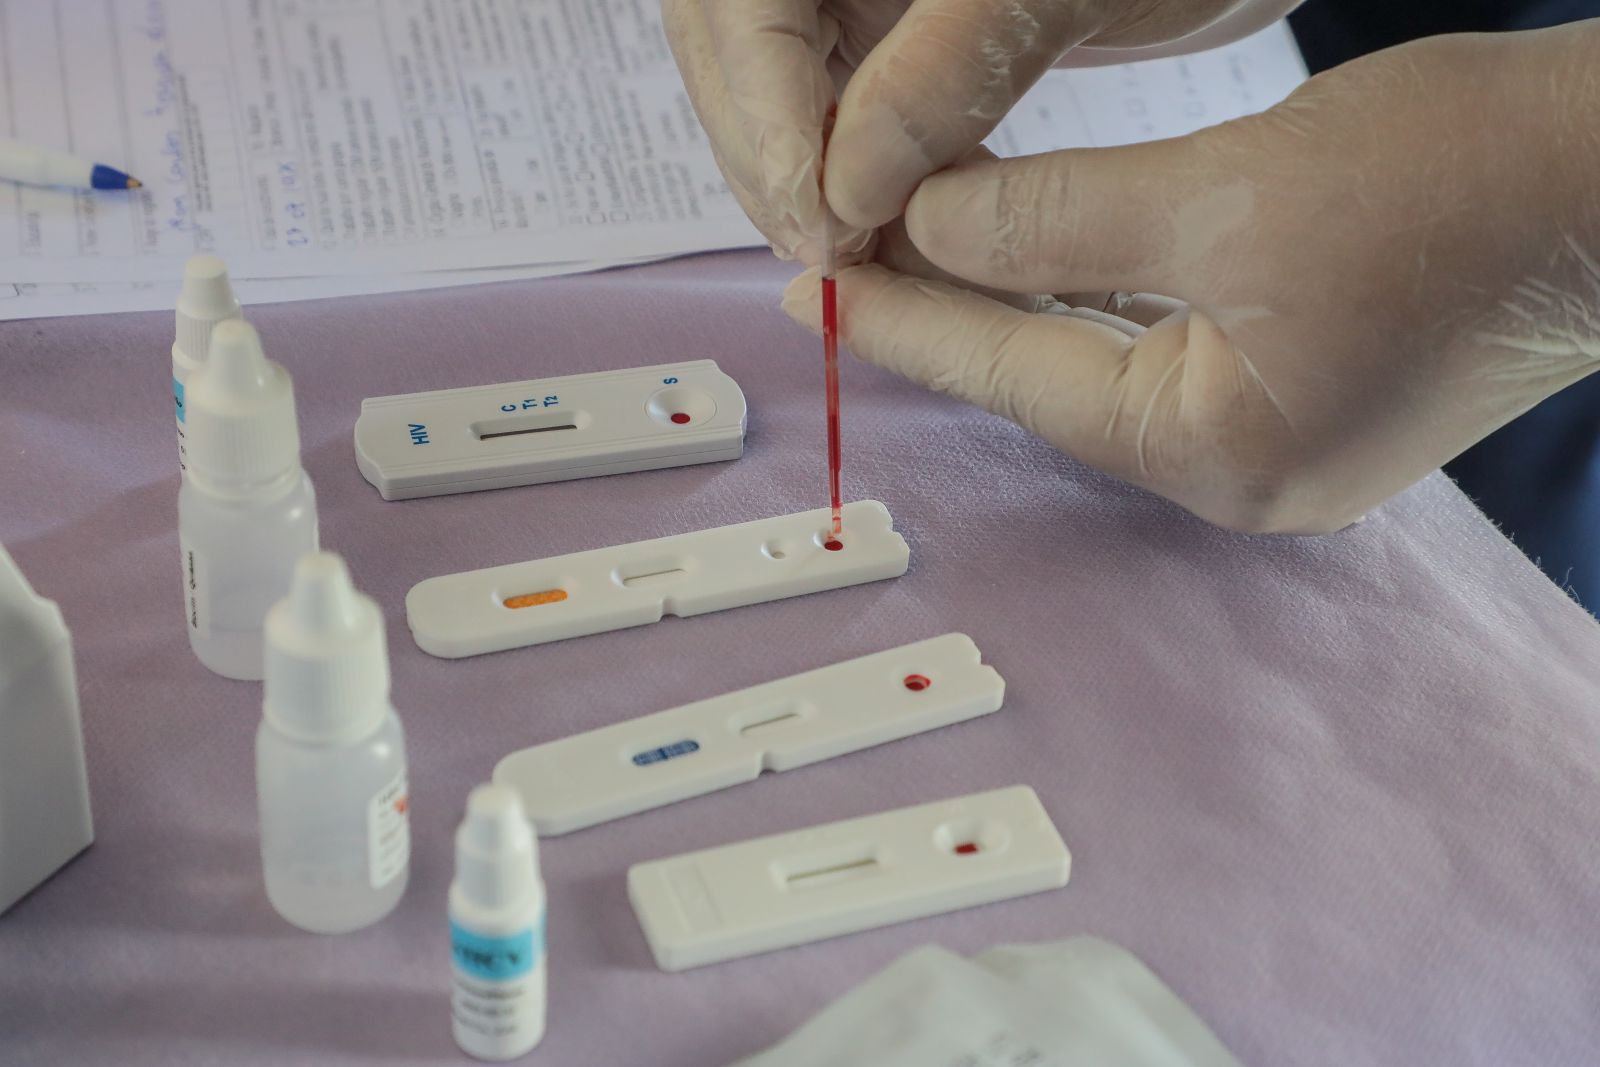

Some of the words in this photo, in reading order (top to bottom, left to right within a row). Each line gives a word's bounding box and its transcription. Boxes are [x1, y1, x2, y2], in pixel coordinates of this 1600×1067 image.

[663, 377, 678, 385] S
[522, 398, 537, 410] T1
[543, 395, 559, 407] T2
[501, 404, 517, 412] C
[408, 423, 430, 445] HIV
